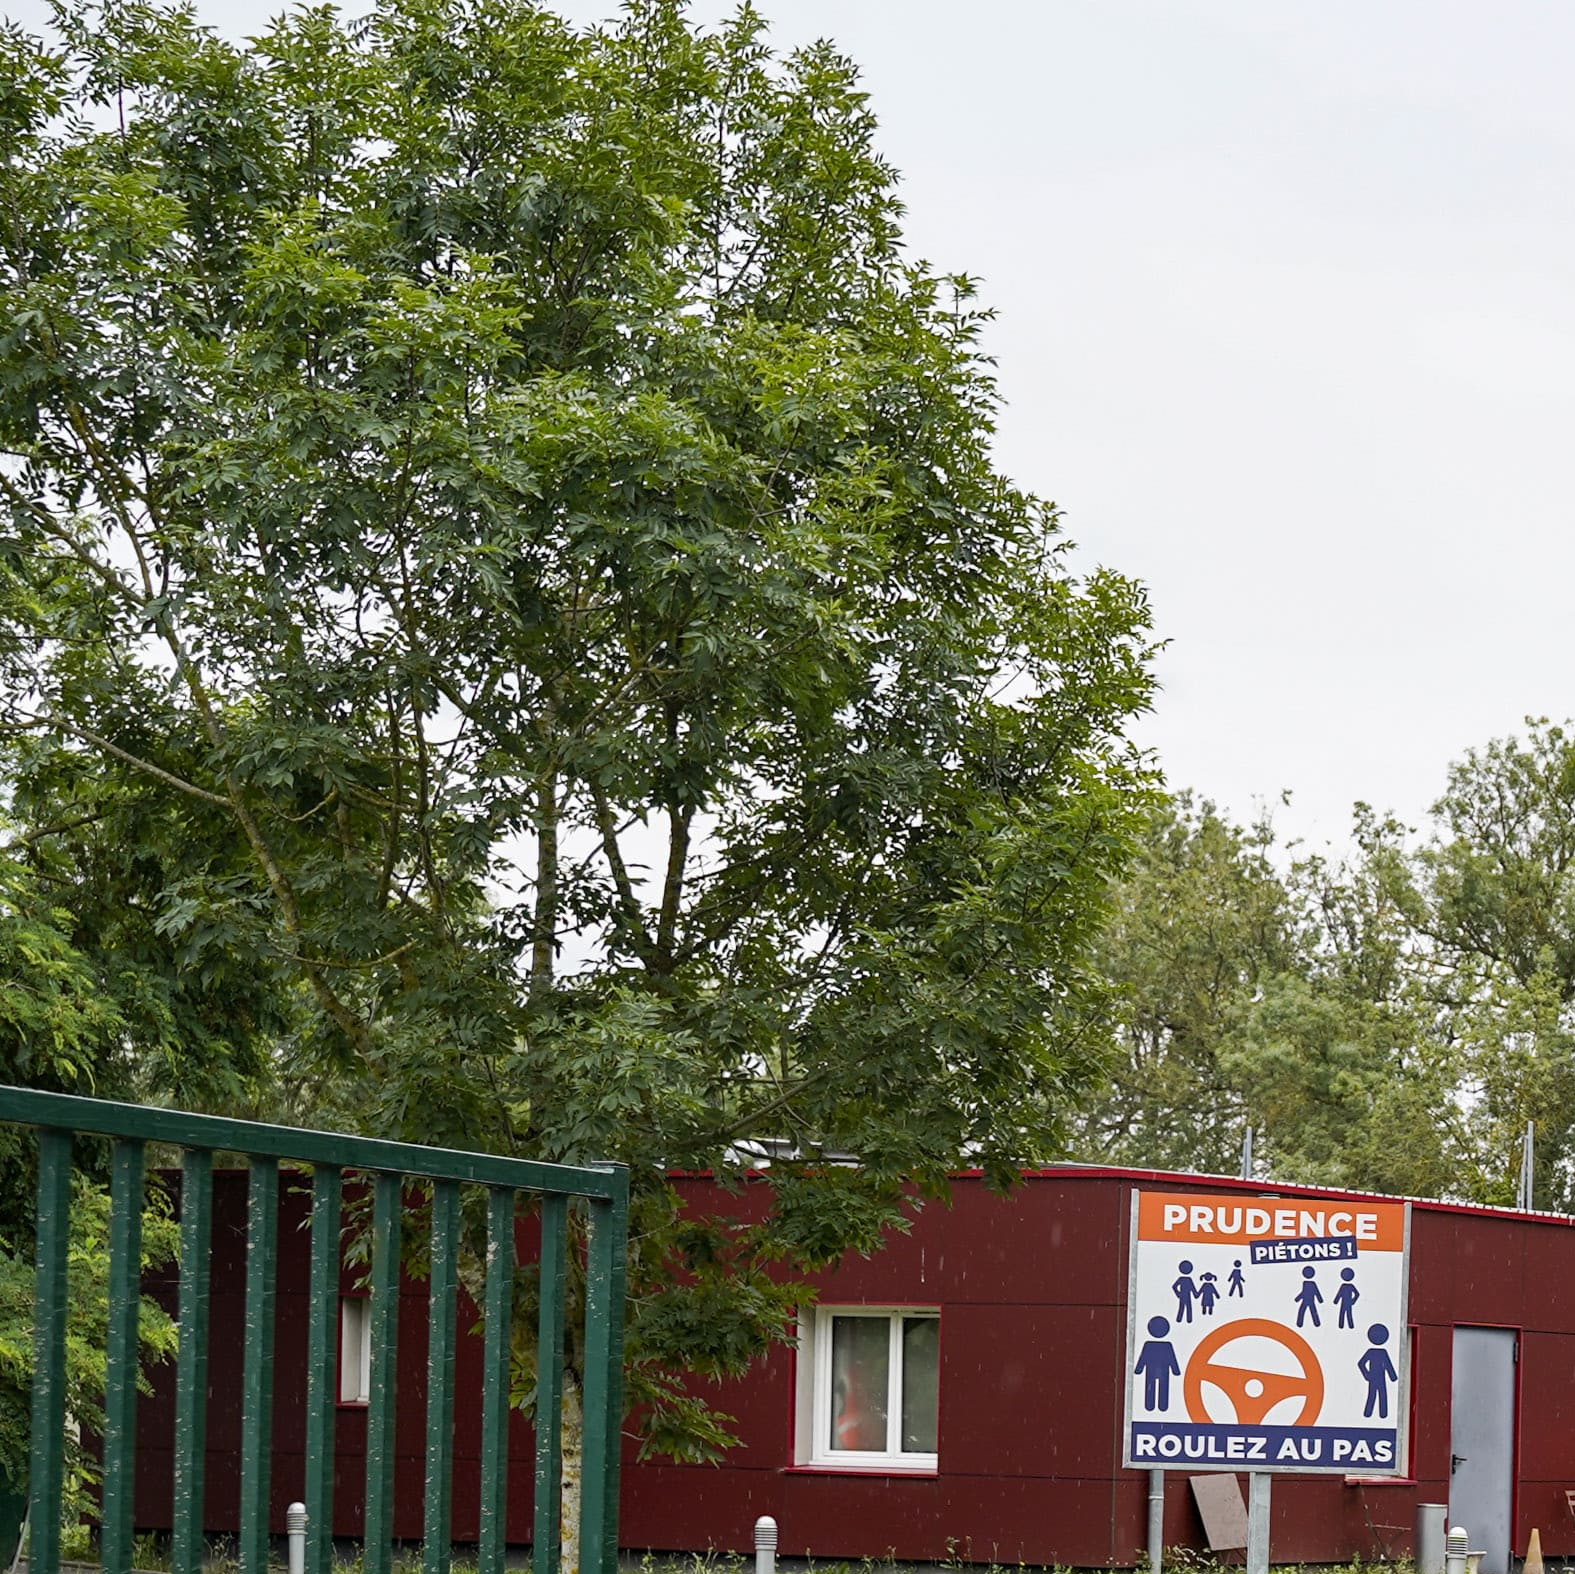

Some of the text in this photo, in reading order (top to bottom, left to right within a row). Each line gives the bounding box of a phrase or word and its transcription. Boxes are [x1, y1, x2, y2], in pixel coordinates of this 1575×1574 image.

[1164, 1204, 1377, 1240] PRUDENCE
[1255, 1242, 1341, 1261] PIÉTONS
[1136, 1433, 1392, 1462] ROULEZ AU PAS
